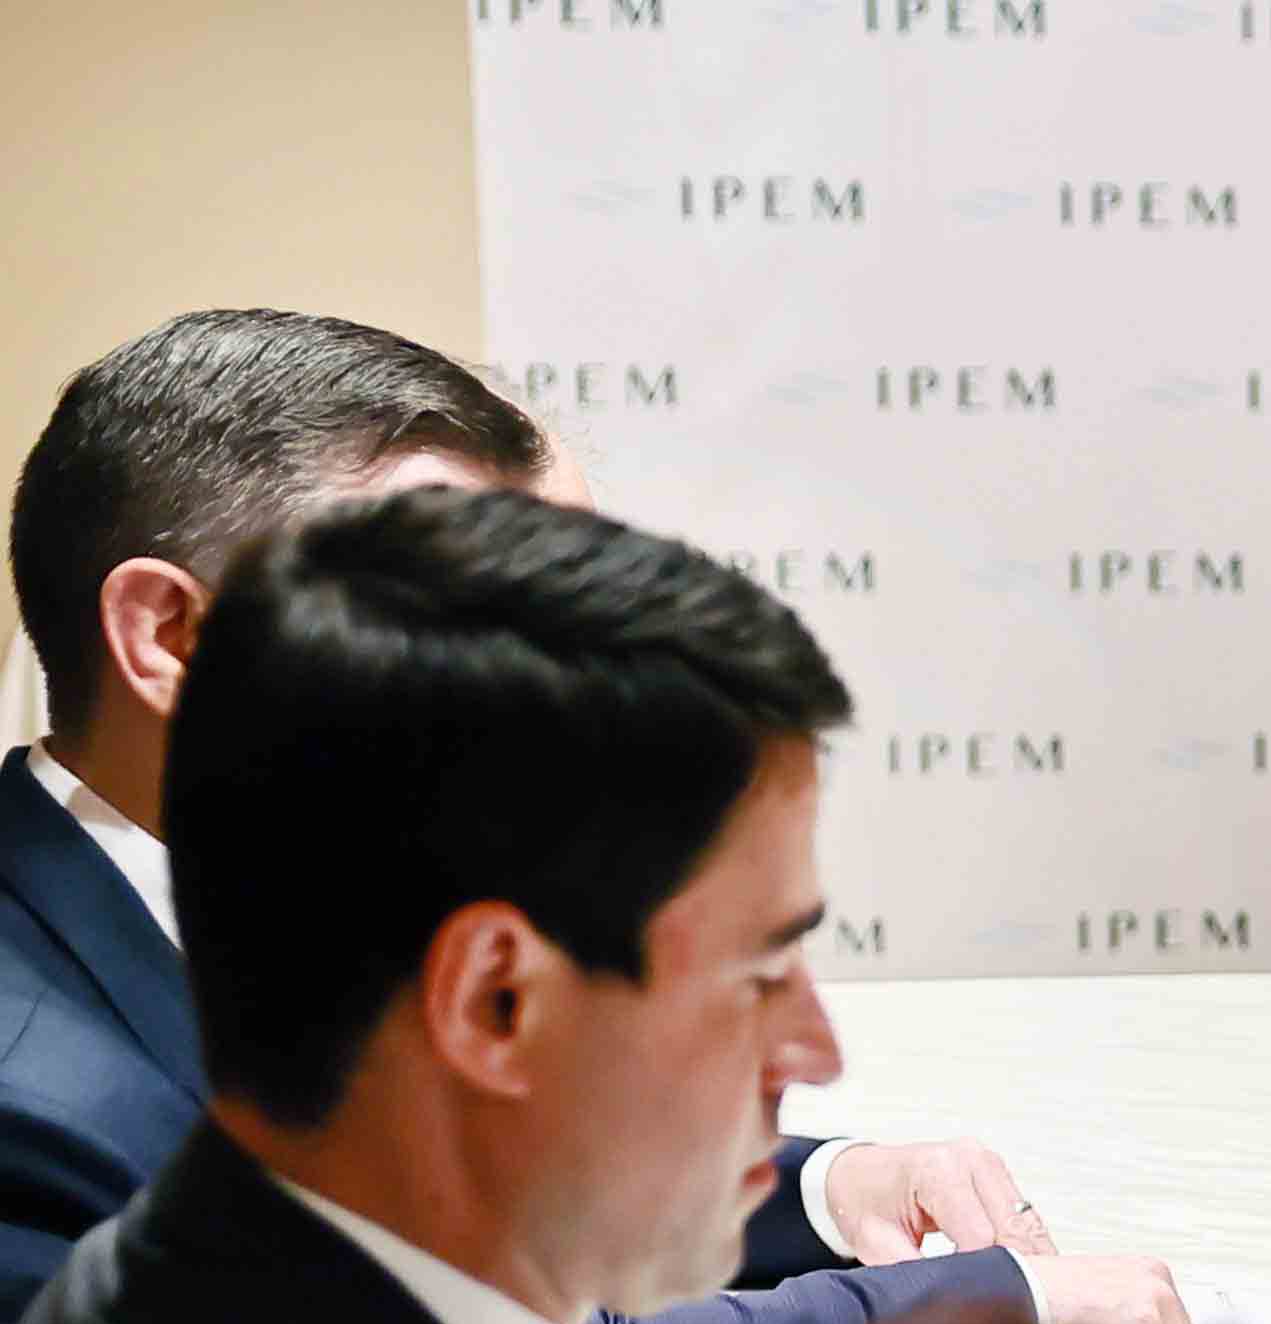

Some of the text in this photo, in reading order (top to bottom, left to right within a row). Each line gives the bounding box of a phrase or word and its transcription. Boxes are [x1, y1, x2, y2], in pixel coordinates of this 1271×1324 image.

[865, 0, 1048, 37] IPEM
[680, 176, 866, 224] IPEM
[1059, 182, 1239, 229] IPEM
[876, 366, 1057, 411] IPEM
[1068, 550, 1246, 594] IPEM
[888, 732, 1066, 775] IPEM
[1077, 909, 1252, 953] IPEM
